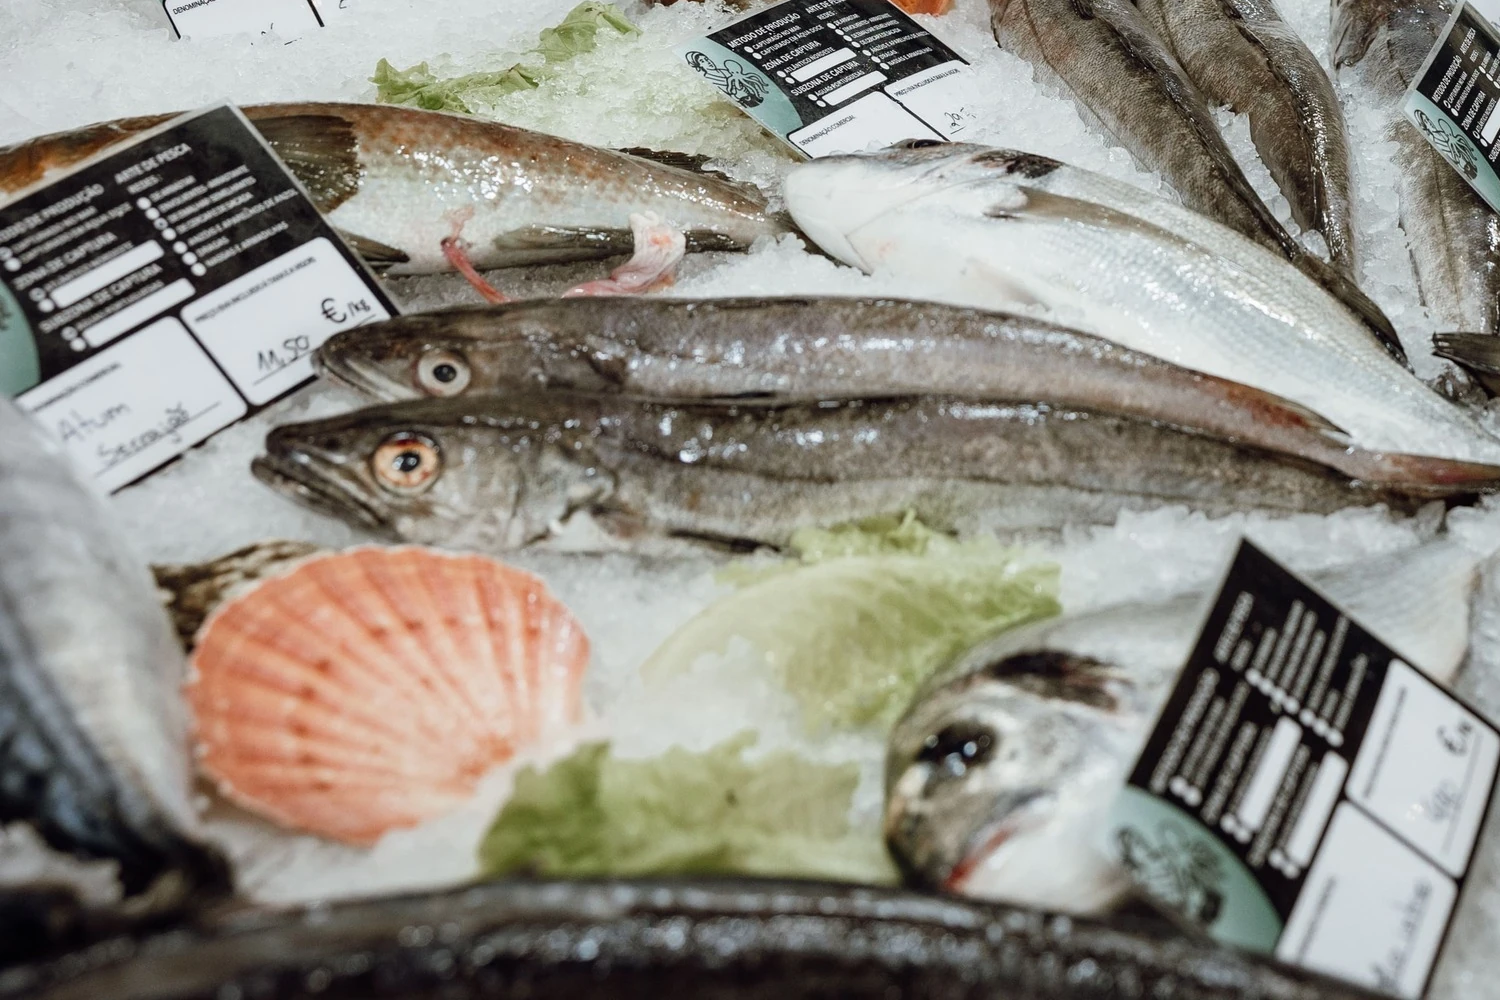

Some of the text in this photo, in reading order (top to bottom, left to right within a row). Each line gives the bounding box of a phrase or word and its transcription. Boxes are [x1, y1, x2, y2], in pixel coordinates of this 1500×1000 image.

[805, 4, 823, 14] ARTE
[727, 13, 800, 48] METODO DE PRODUÇÃO
[762, 40, 821, 70] ZONA DE CAPTURA
[791, 61, 860, 96] SUBZONA DE CAPTURA
